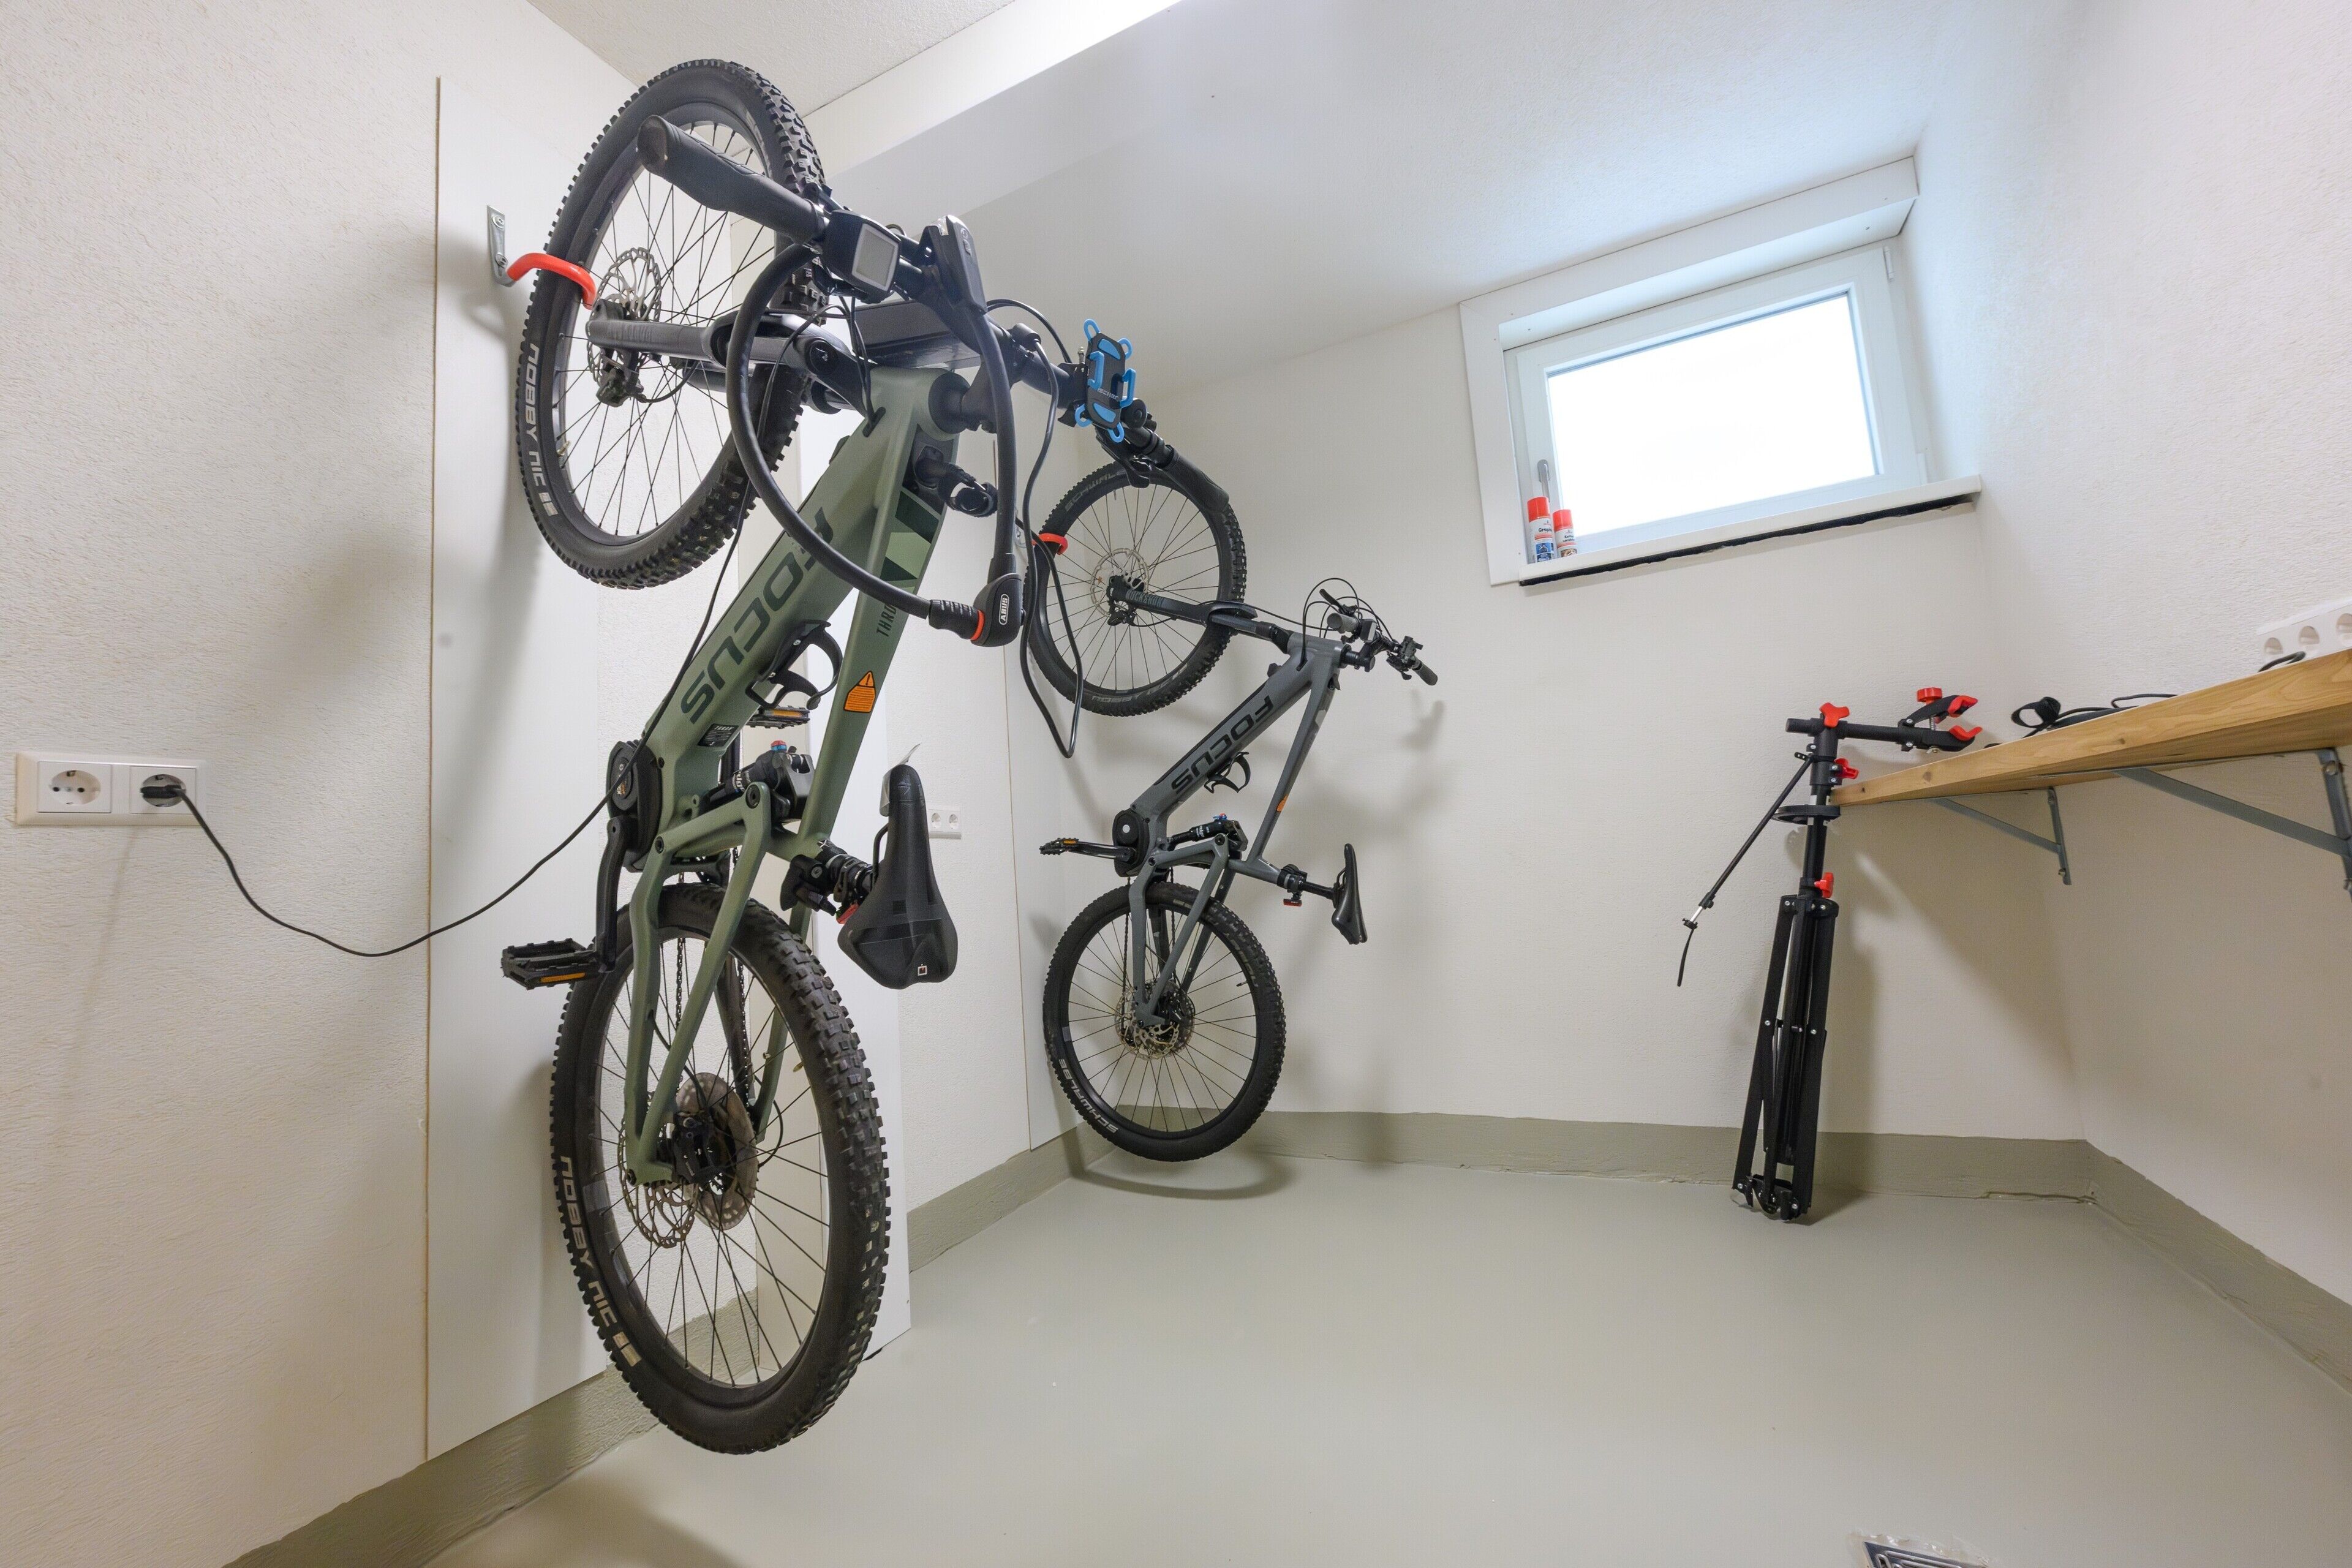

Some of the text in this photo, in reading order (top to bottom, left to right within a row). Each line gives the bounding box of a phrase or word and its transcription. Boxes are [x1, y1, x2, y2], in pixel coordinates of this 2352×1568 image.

[525, 343, 546, 486] NOBBY NIC
[1065, 469, 1126, 512] SCHWALB
[876, 604, 897, 637] THRO
[1000, 596, 1009, 623] ABUS
[1171, 695, 1273, 794] FOCUS
[1058, 1058, 1118, 1134] SCHWALBE
[560, 1155, 617, 1327] NOBBY NIC
